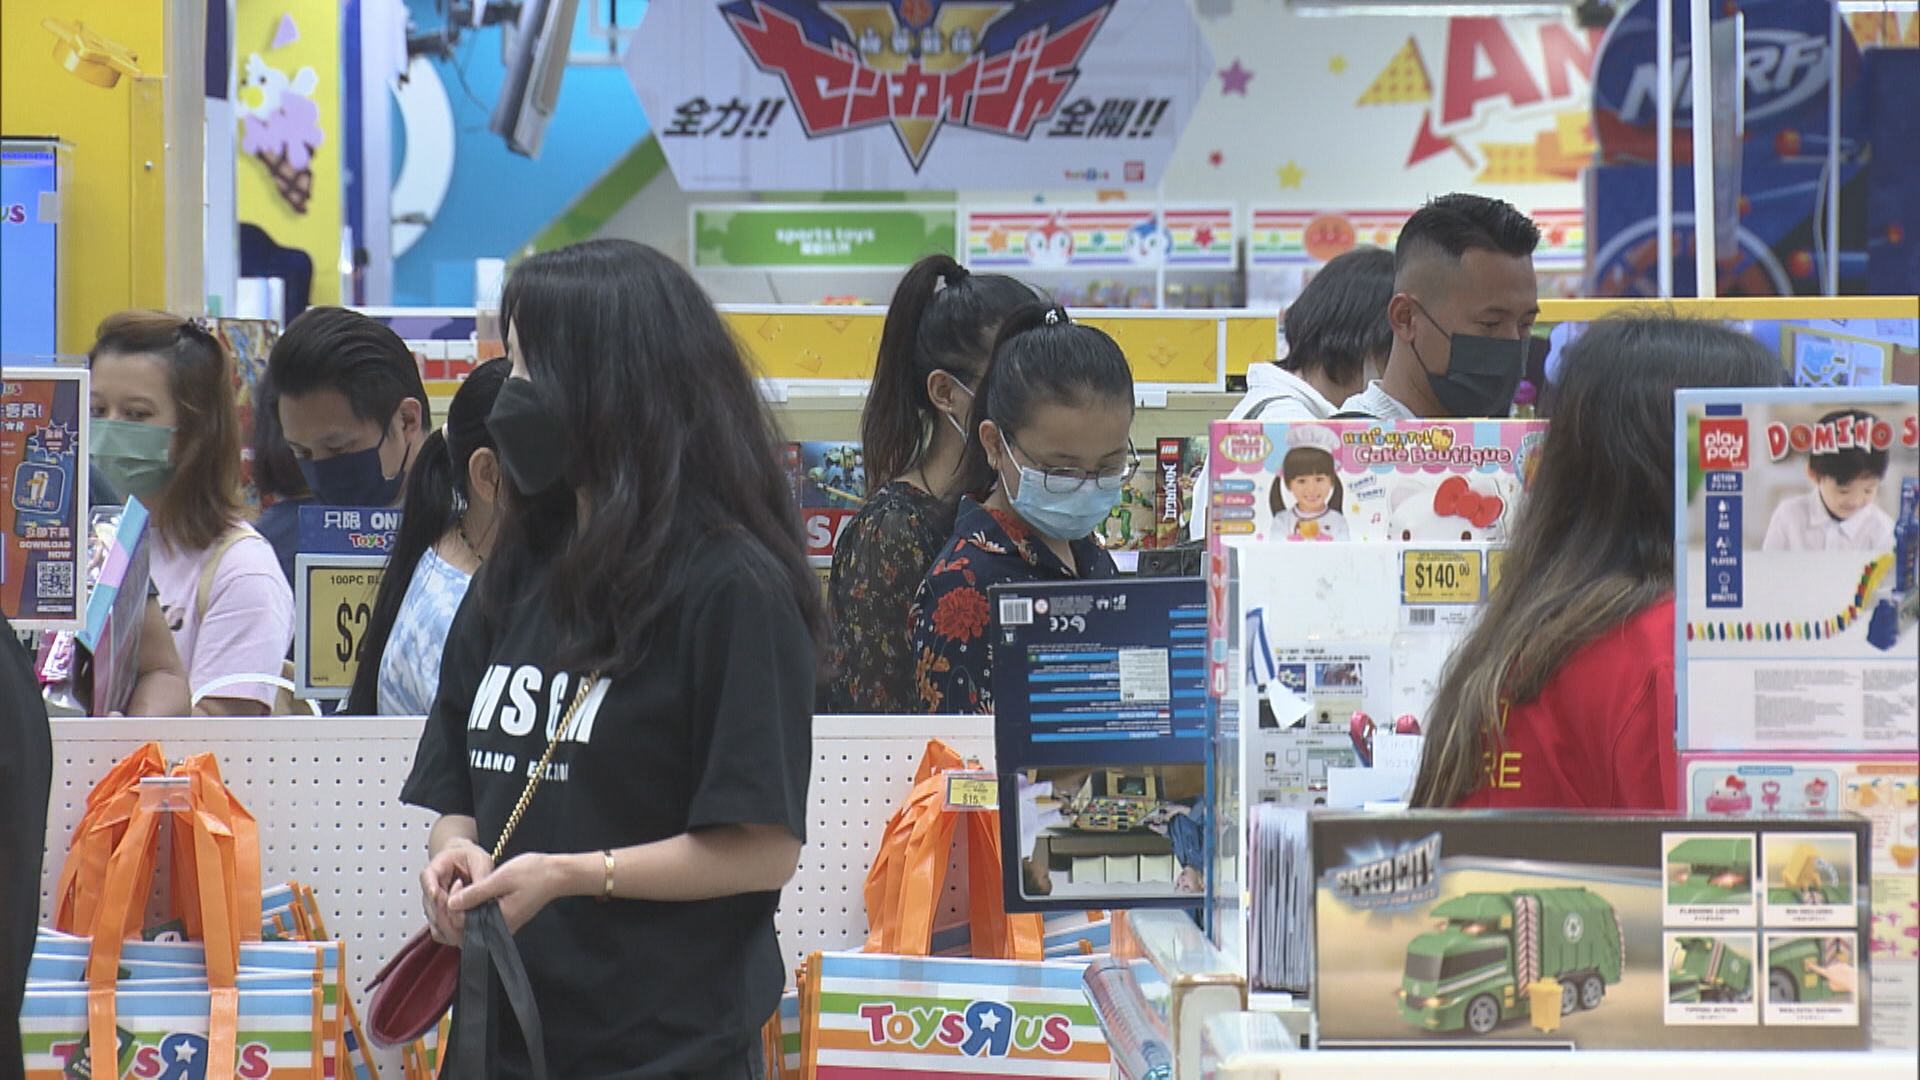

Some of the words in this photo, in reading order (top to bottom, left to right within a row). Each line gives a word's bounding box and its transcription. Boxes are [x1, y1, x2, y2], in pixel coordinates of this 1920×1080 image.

[662, 97, 785, 138] 全力!!
[1047, 98, 1170, 139] 全開!!
[1704, 428, 1744, 449] play
[1767, 415, 1895, 462] DOMINO
[1355, 446, 1409, 465] Cake
[1411, 446, 1512, 468] Boutique
[1706, 446, 1743, 464] pop
[323, 511, 361, 529] 只限
[19, 540, 71, 549] DOWNLOAD
[47, 551, 71, 560] NOW
[331, 575, 364, 585] 100PC
